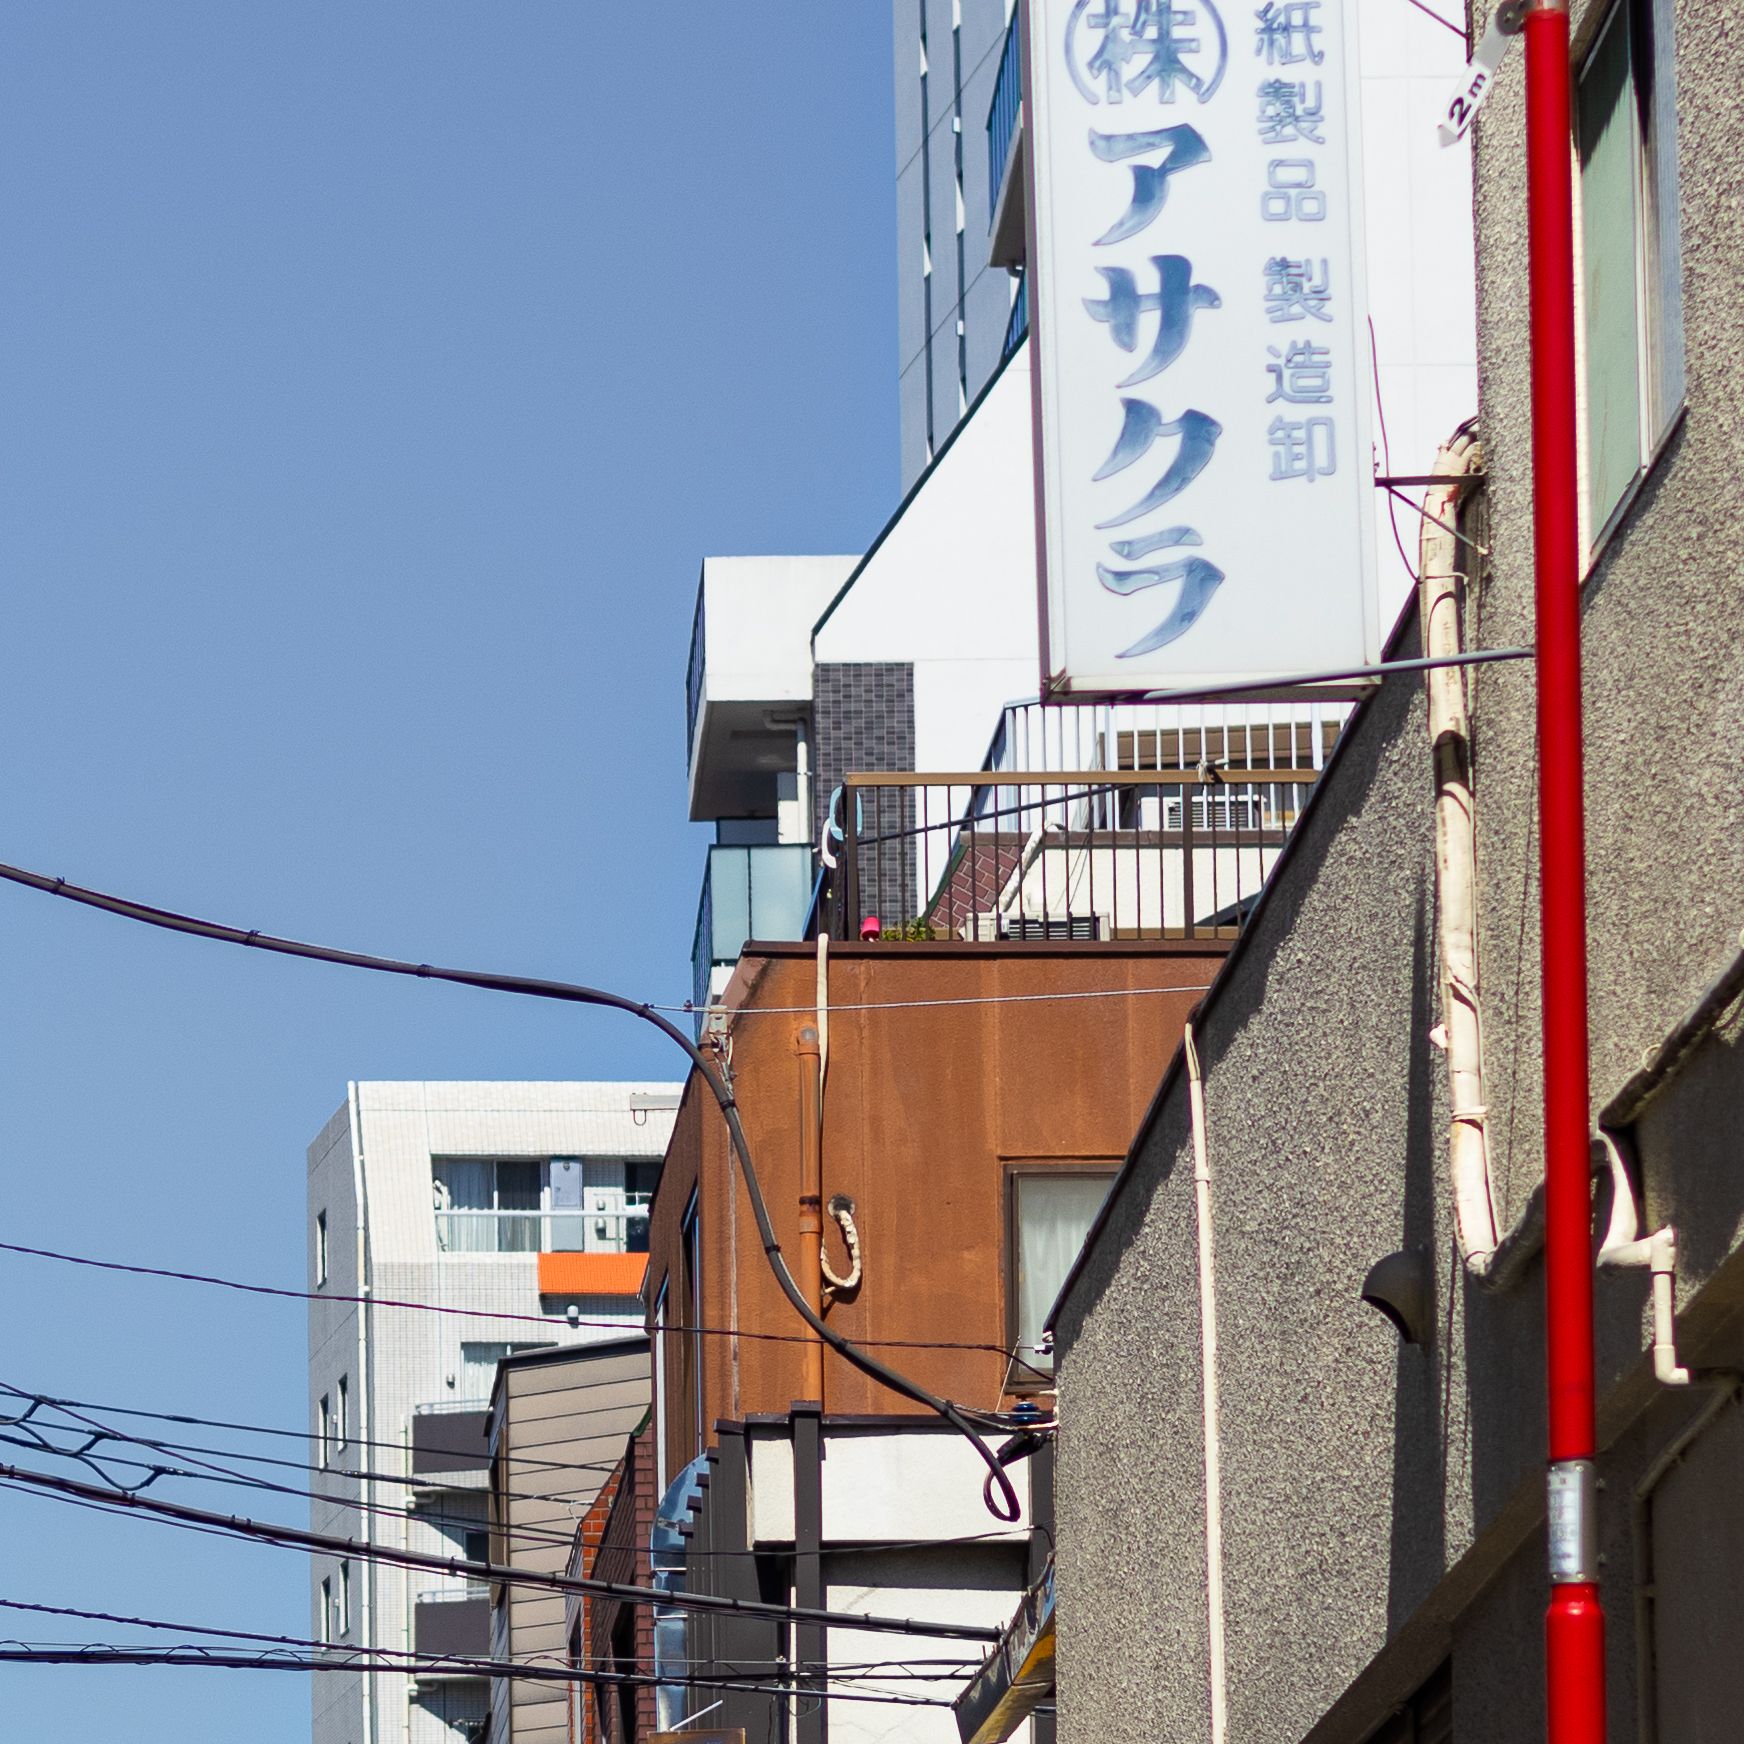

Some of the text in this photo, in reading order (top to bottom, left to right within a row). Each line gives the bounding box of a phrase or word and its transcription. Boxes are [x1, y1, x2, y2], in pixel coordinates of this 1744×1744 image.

[1253, 0, 1338, 485] 紙製品製造卸
